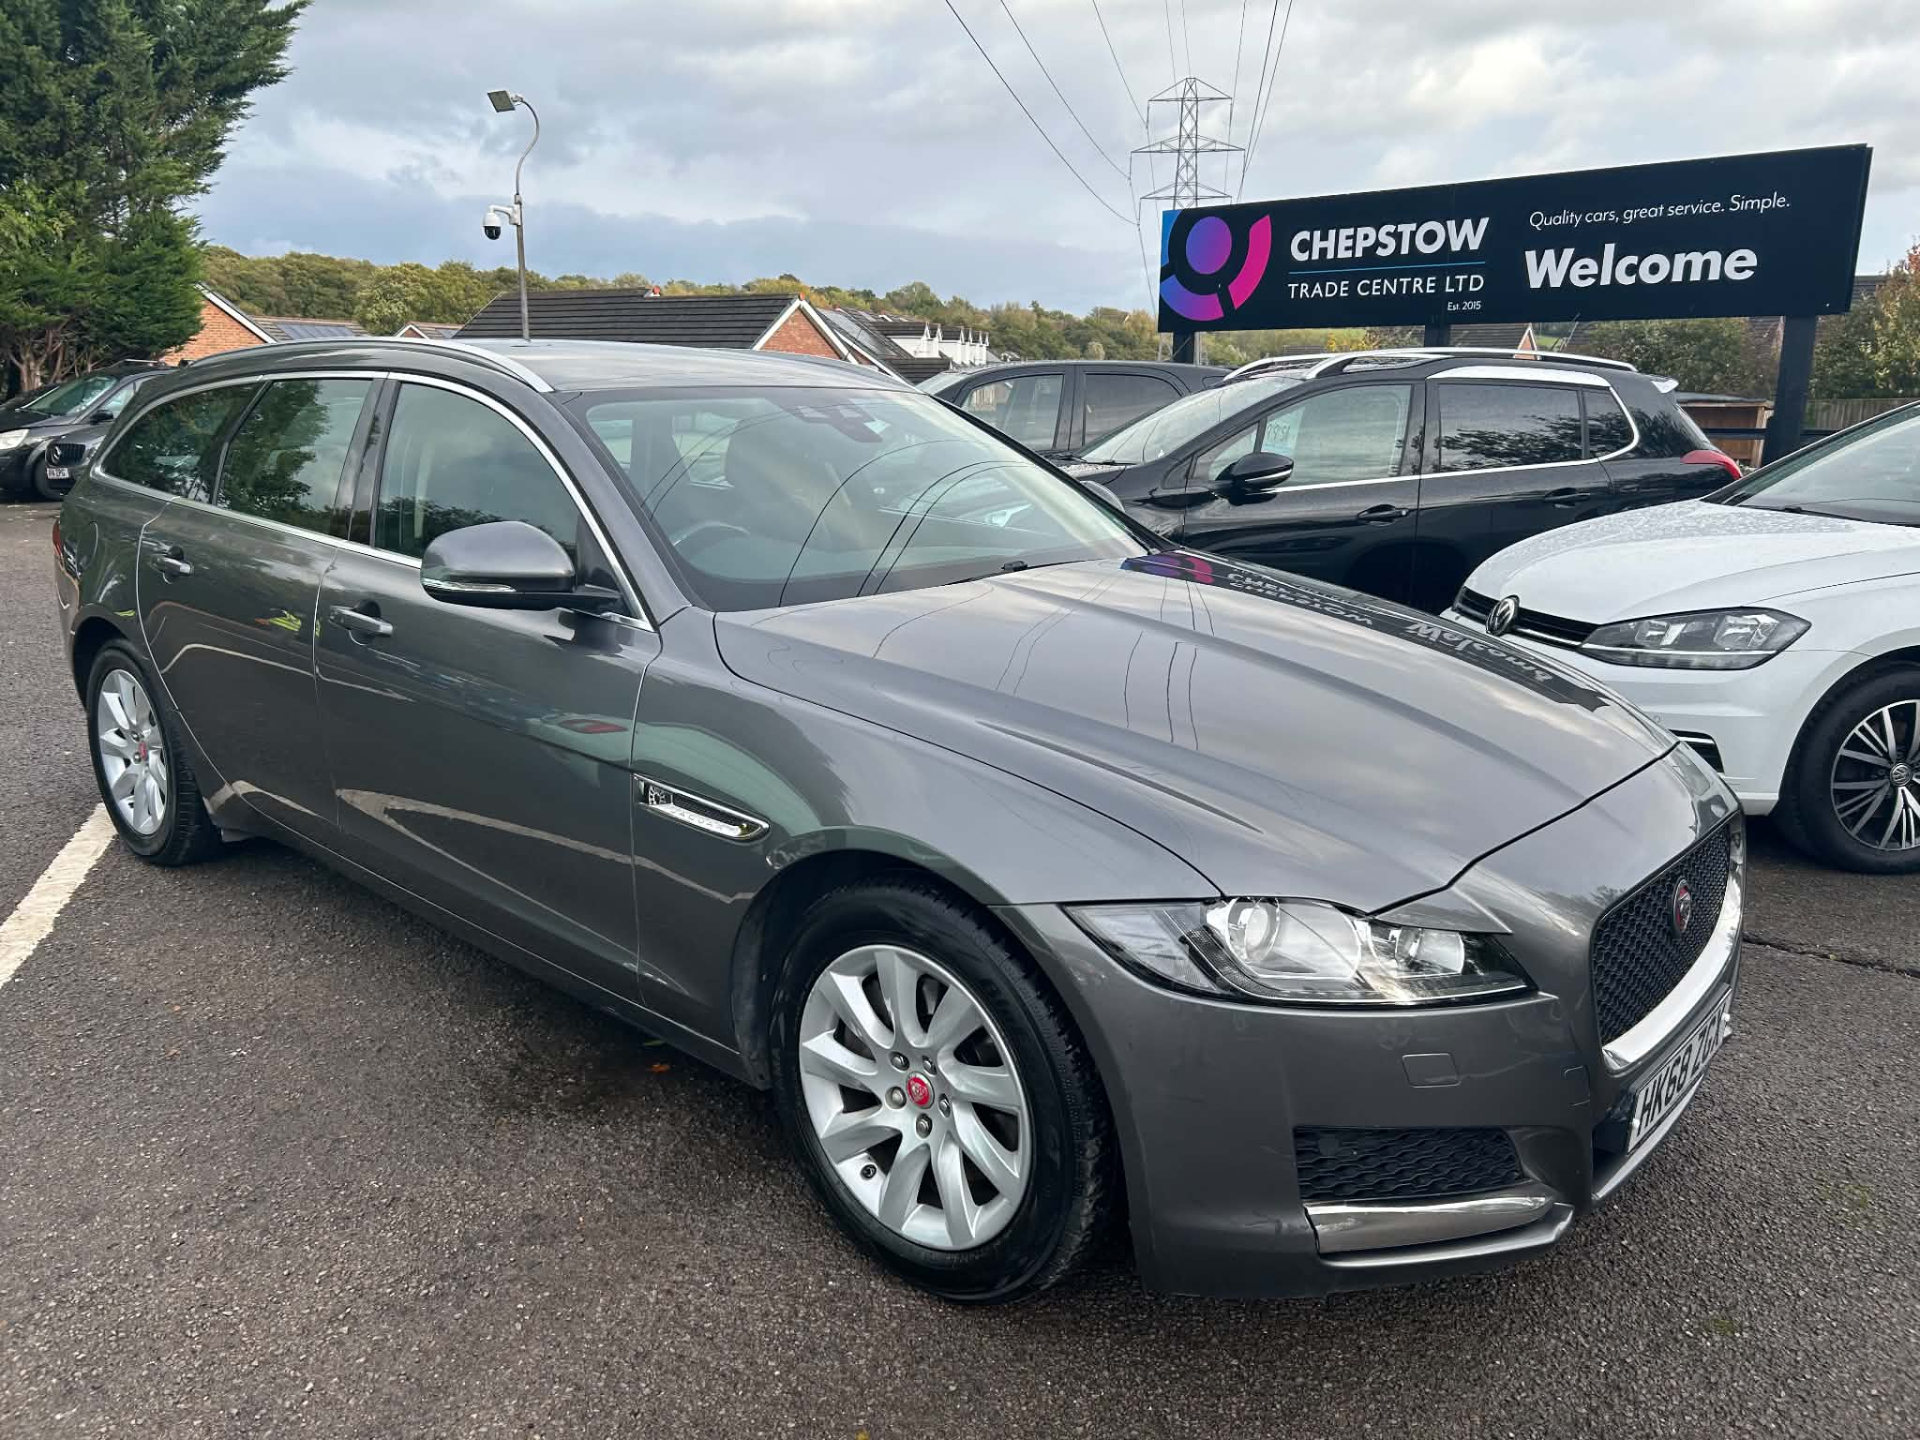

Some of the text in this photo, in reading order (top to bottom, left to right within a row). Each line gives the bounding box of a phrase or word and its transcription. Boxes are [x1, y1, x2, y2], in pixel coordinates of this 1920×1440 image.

[1529, 191, 1791, 230] Quality cars, great service. Simple.
[1290, 216, 1490, 261] CHEPSTOW
[1288, 274, 1485, 299] TRADE CENTRE LTD
[1524, 242, 1758, 289] Welcome
[1447, 301, 1482, 311] Est. 2015
[1636, 1043, 1693, 1137] HK68
